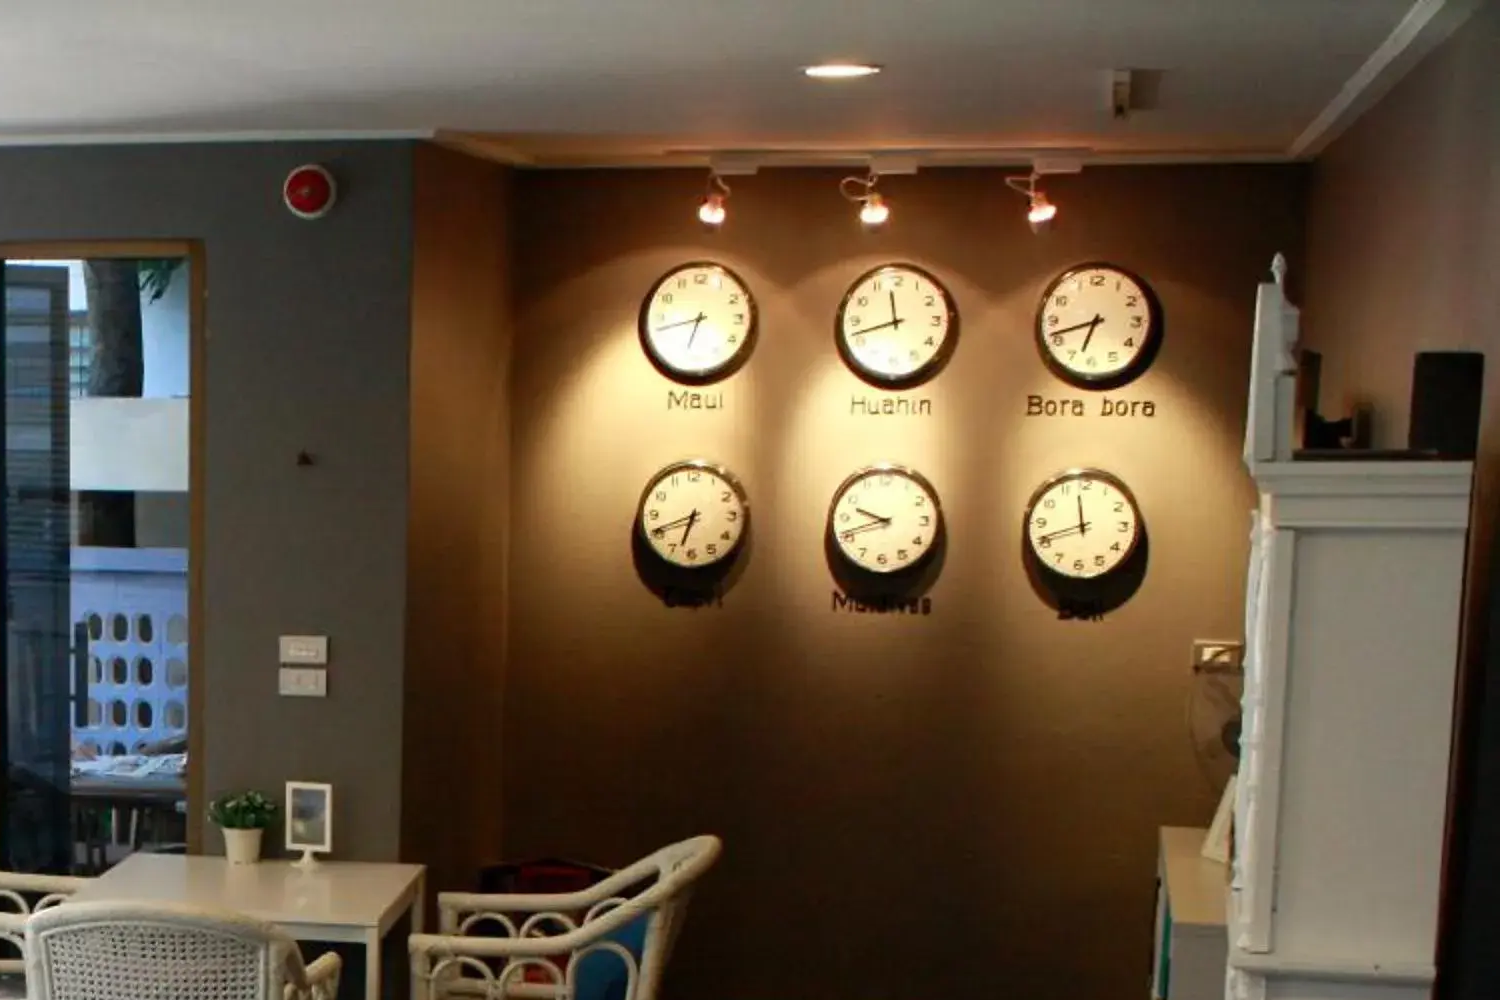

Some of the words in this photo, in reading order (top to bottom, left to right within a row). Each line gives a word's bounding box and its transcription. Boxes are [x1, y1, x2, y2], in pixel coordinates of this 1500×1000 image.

[923, 296, 935, 308] 2
[1124, 295, 1137, 308] 2
[930, 315, 941, 327] 3
[1047, 314, 1059, 327] 9
[1129, 314, 1141, 329] 3
[1123, 336, 1134, 348] 4
[1067, 349, 1078, 361] 7
[1107, 350, 1119, 363] 5
[850, 394, 932, 416] Huahin
[1026, 395, 1083, 417] Bora
[1100, 395, 1156, 417] bora
[721, 491, 732, 503] 2
[914, 495, 925, 507] 2
[1113, 501, 1125, 513] 2
[650, 509, 660, 521] 9
[726, 511, 737, 521] 3
[918, 515, 929, 527] 3
[1035, 517, 1048, 529] 9
[1117, 520, 1129, 533] 3
[720, 531, 730, 541] 4
[912, 536, 923, 546] 4
[667, 542, 678, 554] 7
[705, 543, 717, 555] 5
[1109, 541, 1121, 551] 4
[685, 548, 698, 561] 6
[857, 546, 869, 559] 7
[1054, 552, 1066, 564] 7
[876, 553, 889, 566] 6
[1072, 559, 1085, 571] 6
